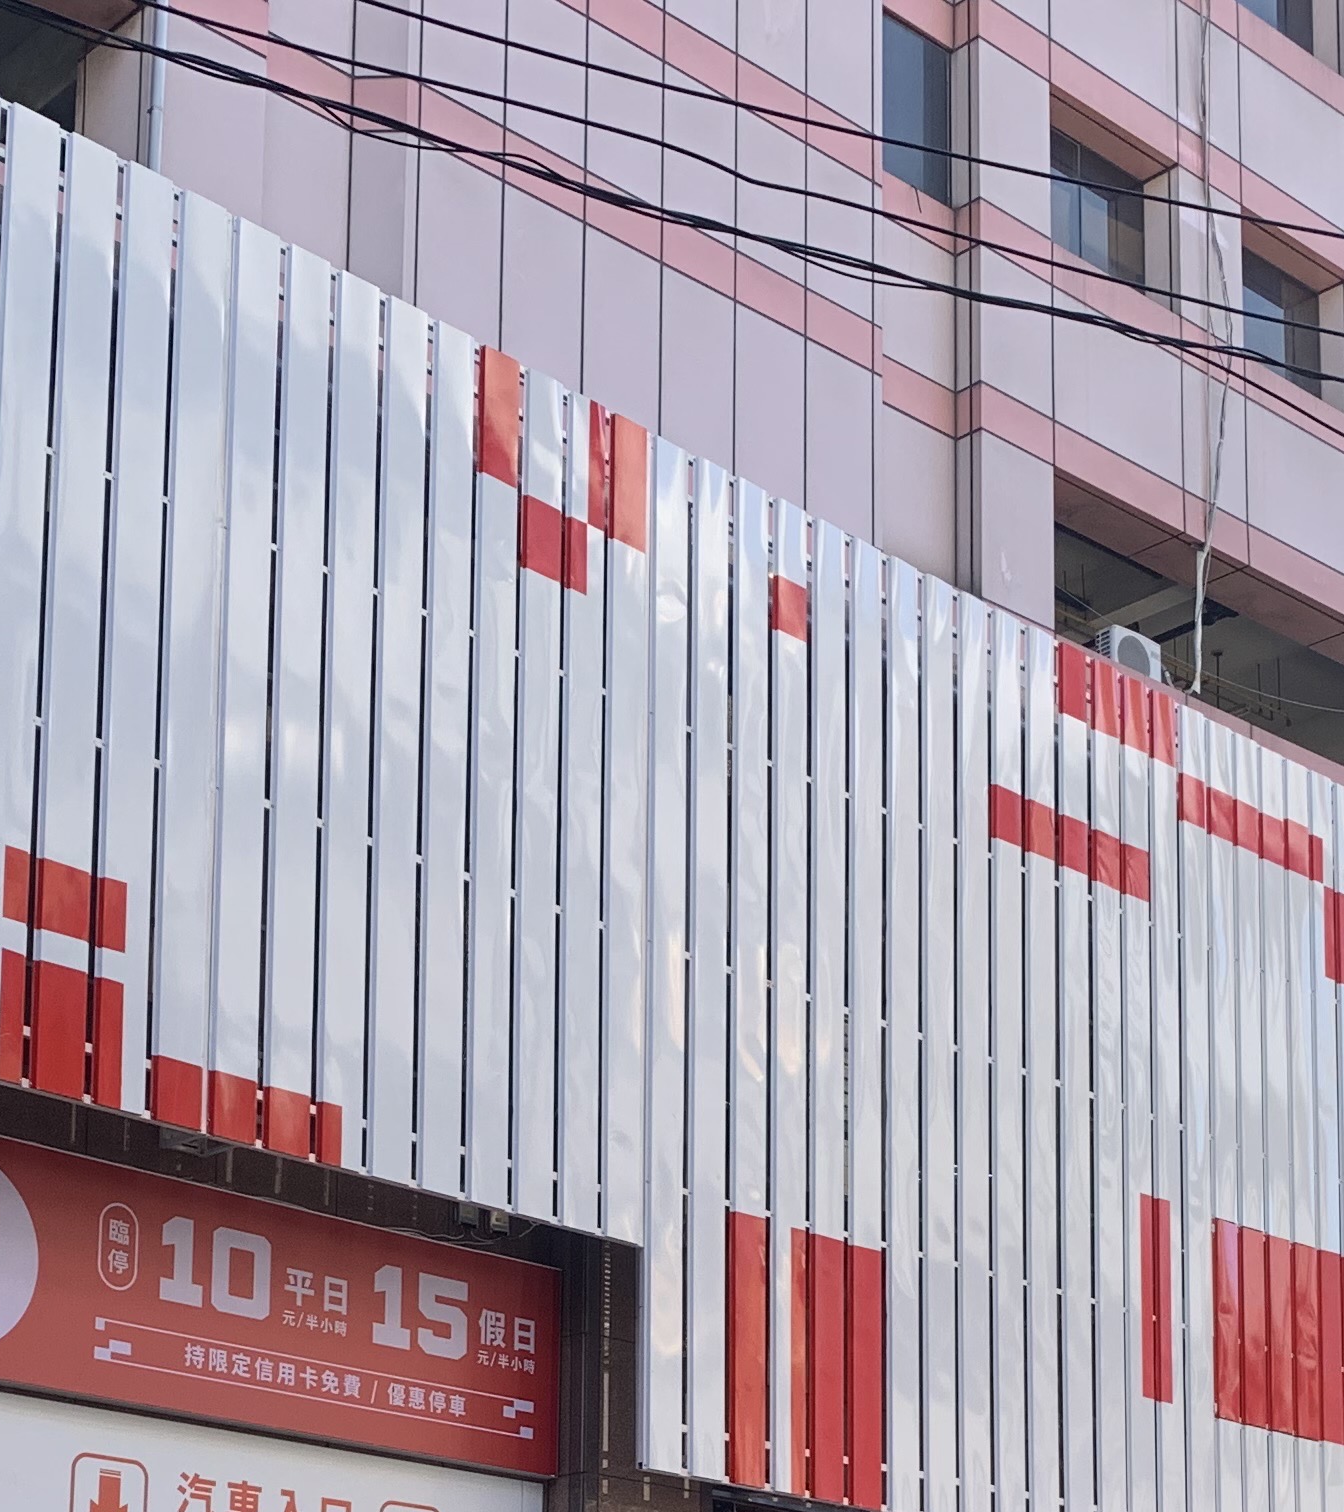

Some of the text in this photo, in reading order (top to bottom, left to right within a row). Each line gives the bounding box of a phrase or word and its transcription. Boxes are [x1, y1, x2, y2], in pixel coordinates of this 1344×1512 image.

[107, 1218, 130, 1276] 臨停
[158, 1215, 272, 1321] 10
[282, 1267, 349, 1316] 平日
[372, 1264, 469, 1361] 15
[282, 1309, 348, 1337] 元/半小時
[478, 1308, 536, 1354] 假日
[183, 1342, 361, 1400] 持限定信用卡免費
[387, 1383, 467, 1418] 優惠停車
[477, 1350, 536, 1376] 元/半小時
